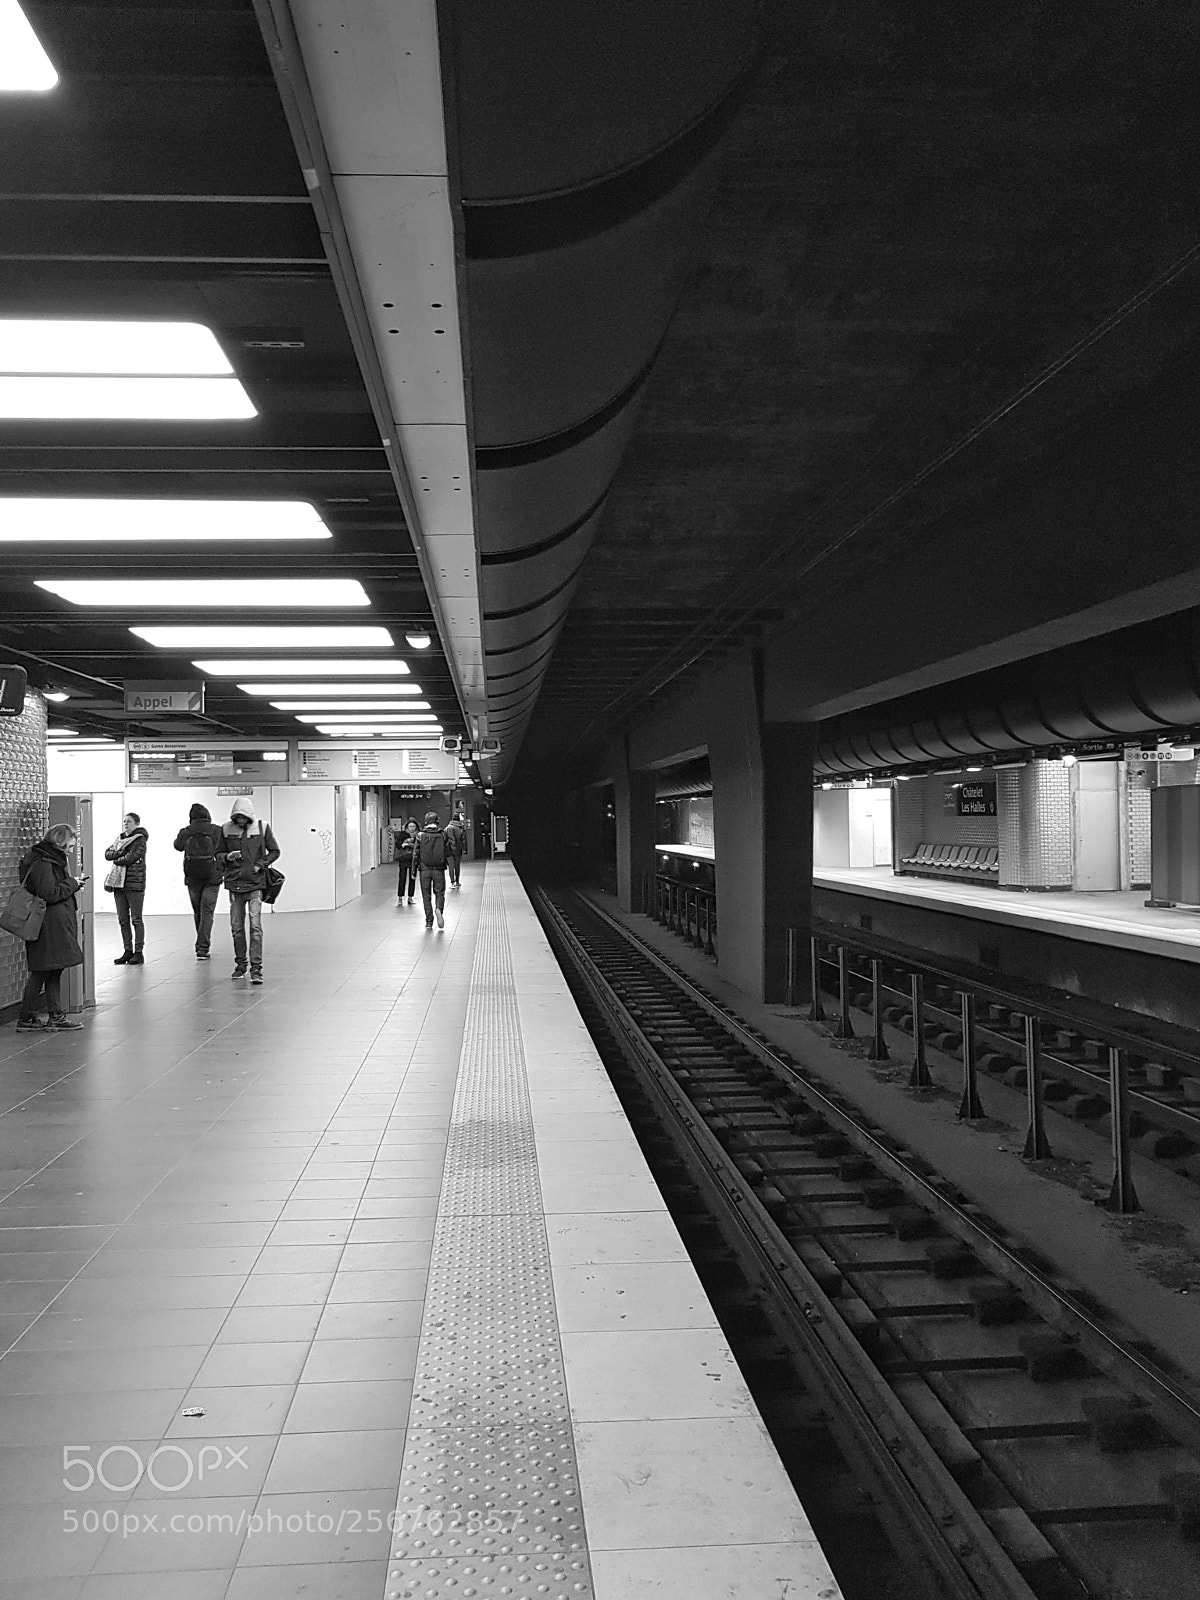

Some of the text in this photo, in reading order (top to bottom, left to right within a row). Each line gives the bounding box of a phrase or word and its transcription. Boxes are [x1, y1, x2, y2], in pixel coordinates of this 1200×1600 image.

[133, 695, 172, 710] Appel
[1083, 743, 1103, 751] Sortie
[962, 787, 984, 798] Châtelet
[961, 801, 986, 813] Les Halles
